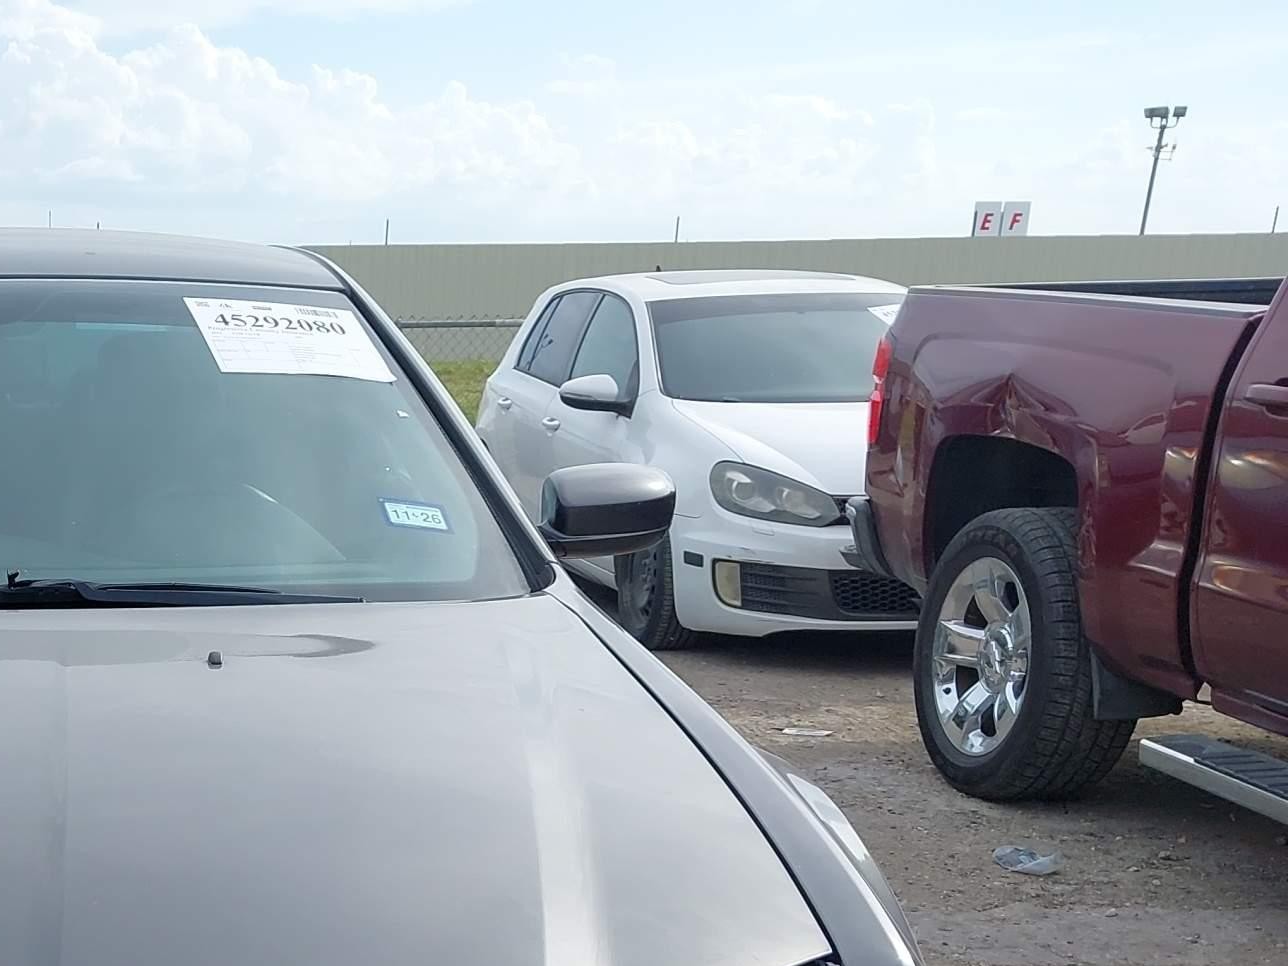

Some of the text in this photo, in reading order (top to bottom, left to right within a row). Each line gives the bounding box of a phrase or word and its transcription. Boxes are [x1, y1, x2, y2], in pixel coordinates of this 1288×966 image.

[980, 212, 994, 231] E
[1008, 212, 1023, 231] F
[214, 312, 347, 336] 45292080
